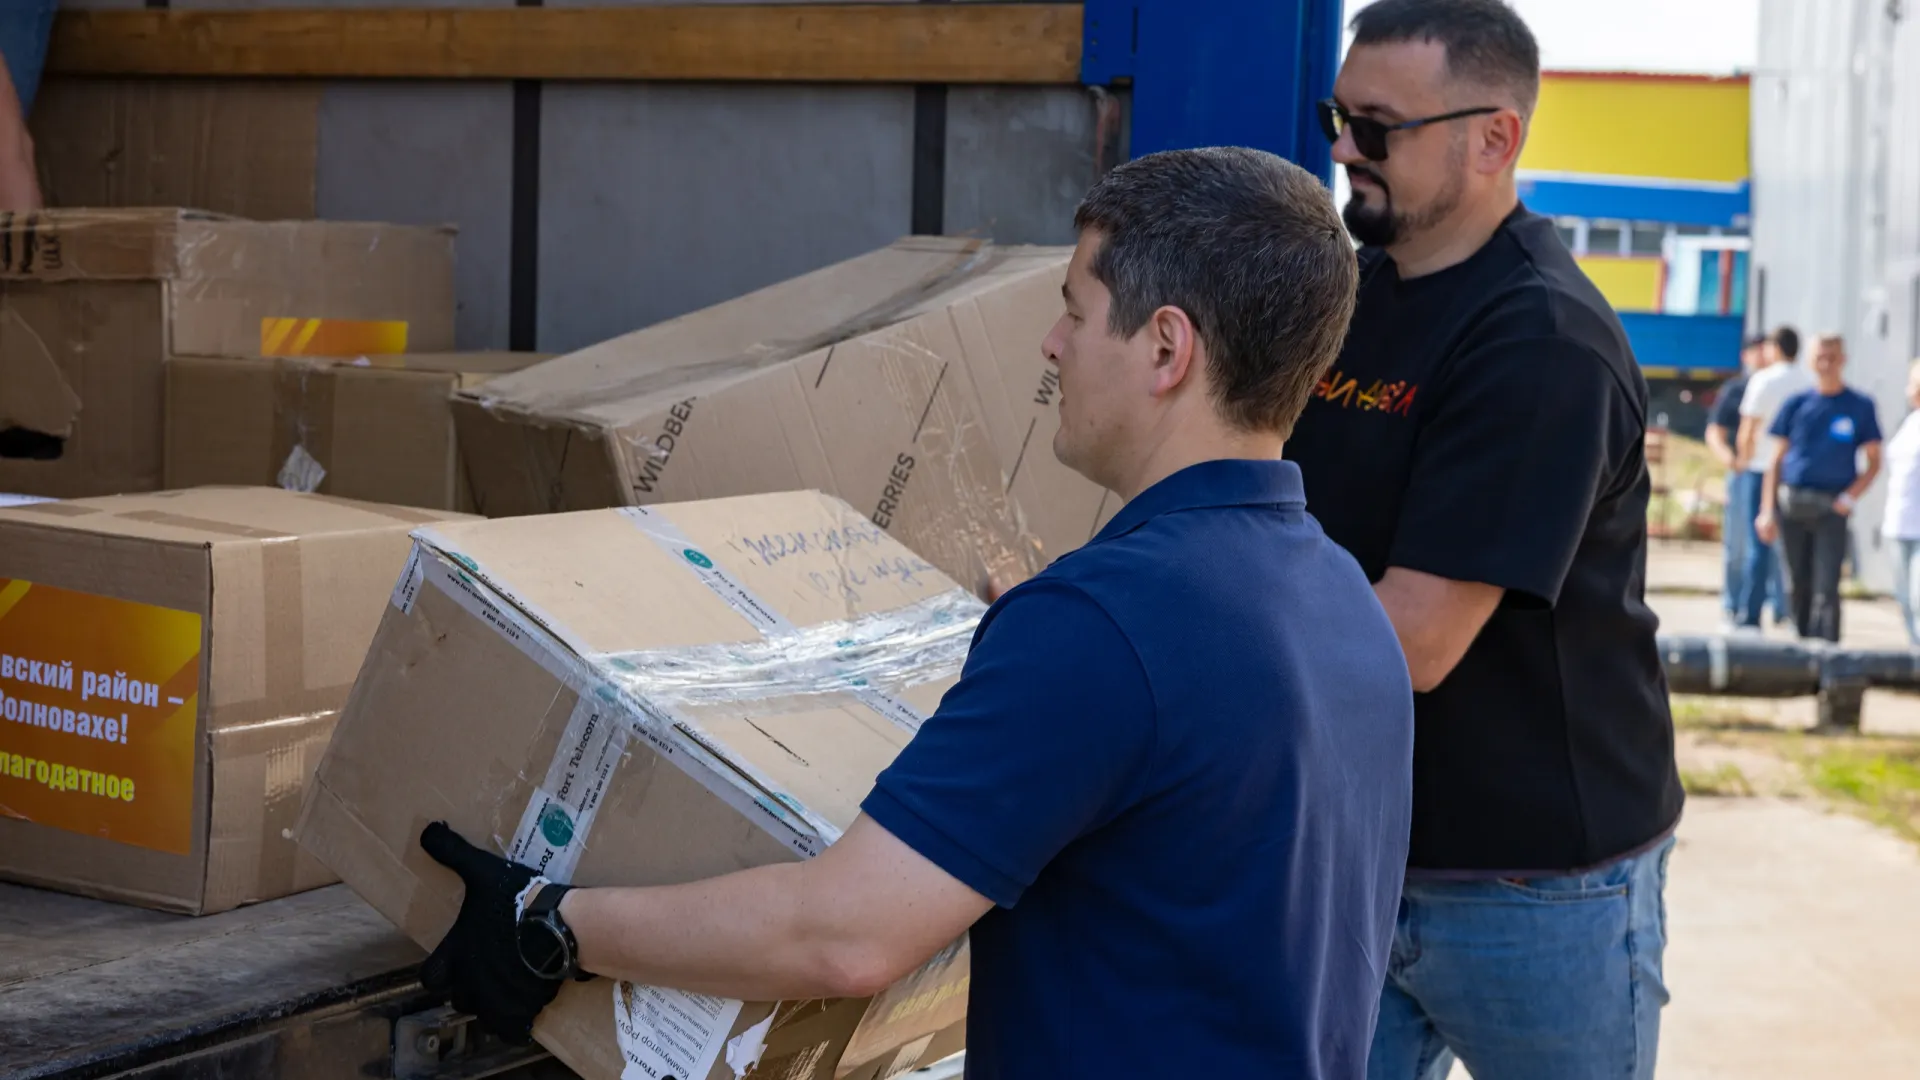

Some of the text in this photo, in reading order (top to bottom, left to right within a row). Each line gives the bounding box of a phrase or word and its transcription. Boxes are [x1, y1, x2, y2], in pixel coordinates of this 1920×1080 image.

[871, 452, 915, 529] ERRIES
[738, 590, 776, 624] Telecom
[1, 654, 73, 691] вский
[82, 670, 159, 707] район
[557, 772, 574, 801] Fort
[569, 713, 599, 769] Telecom
[641, 1036, 690, 1079] Коммутатор
